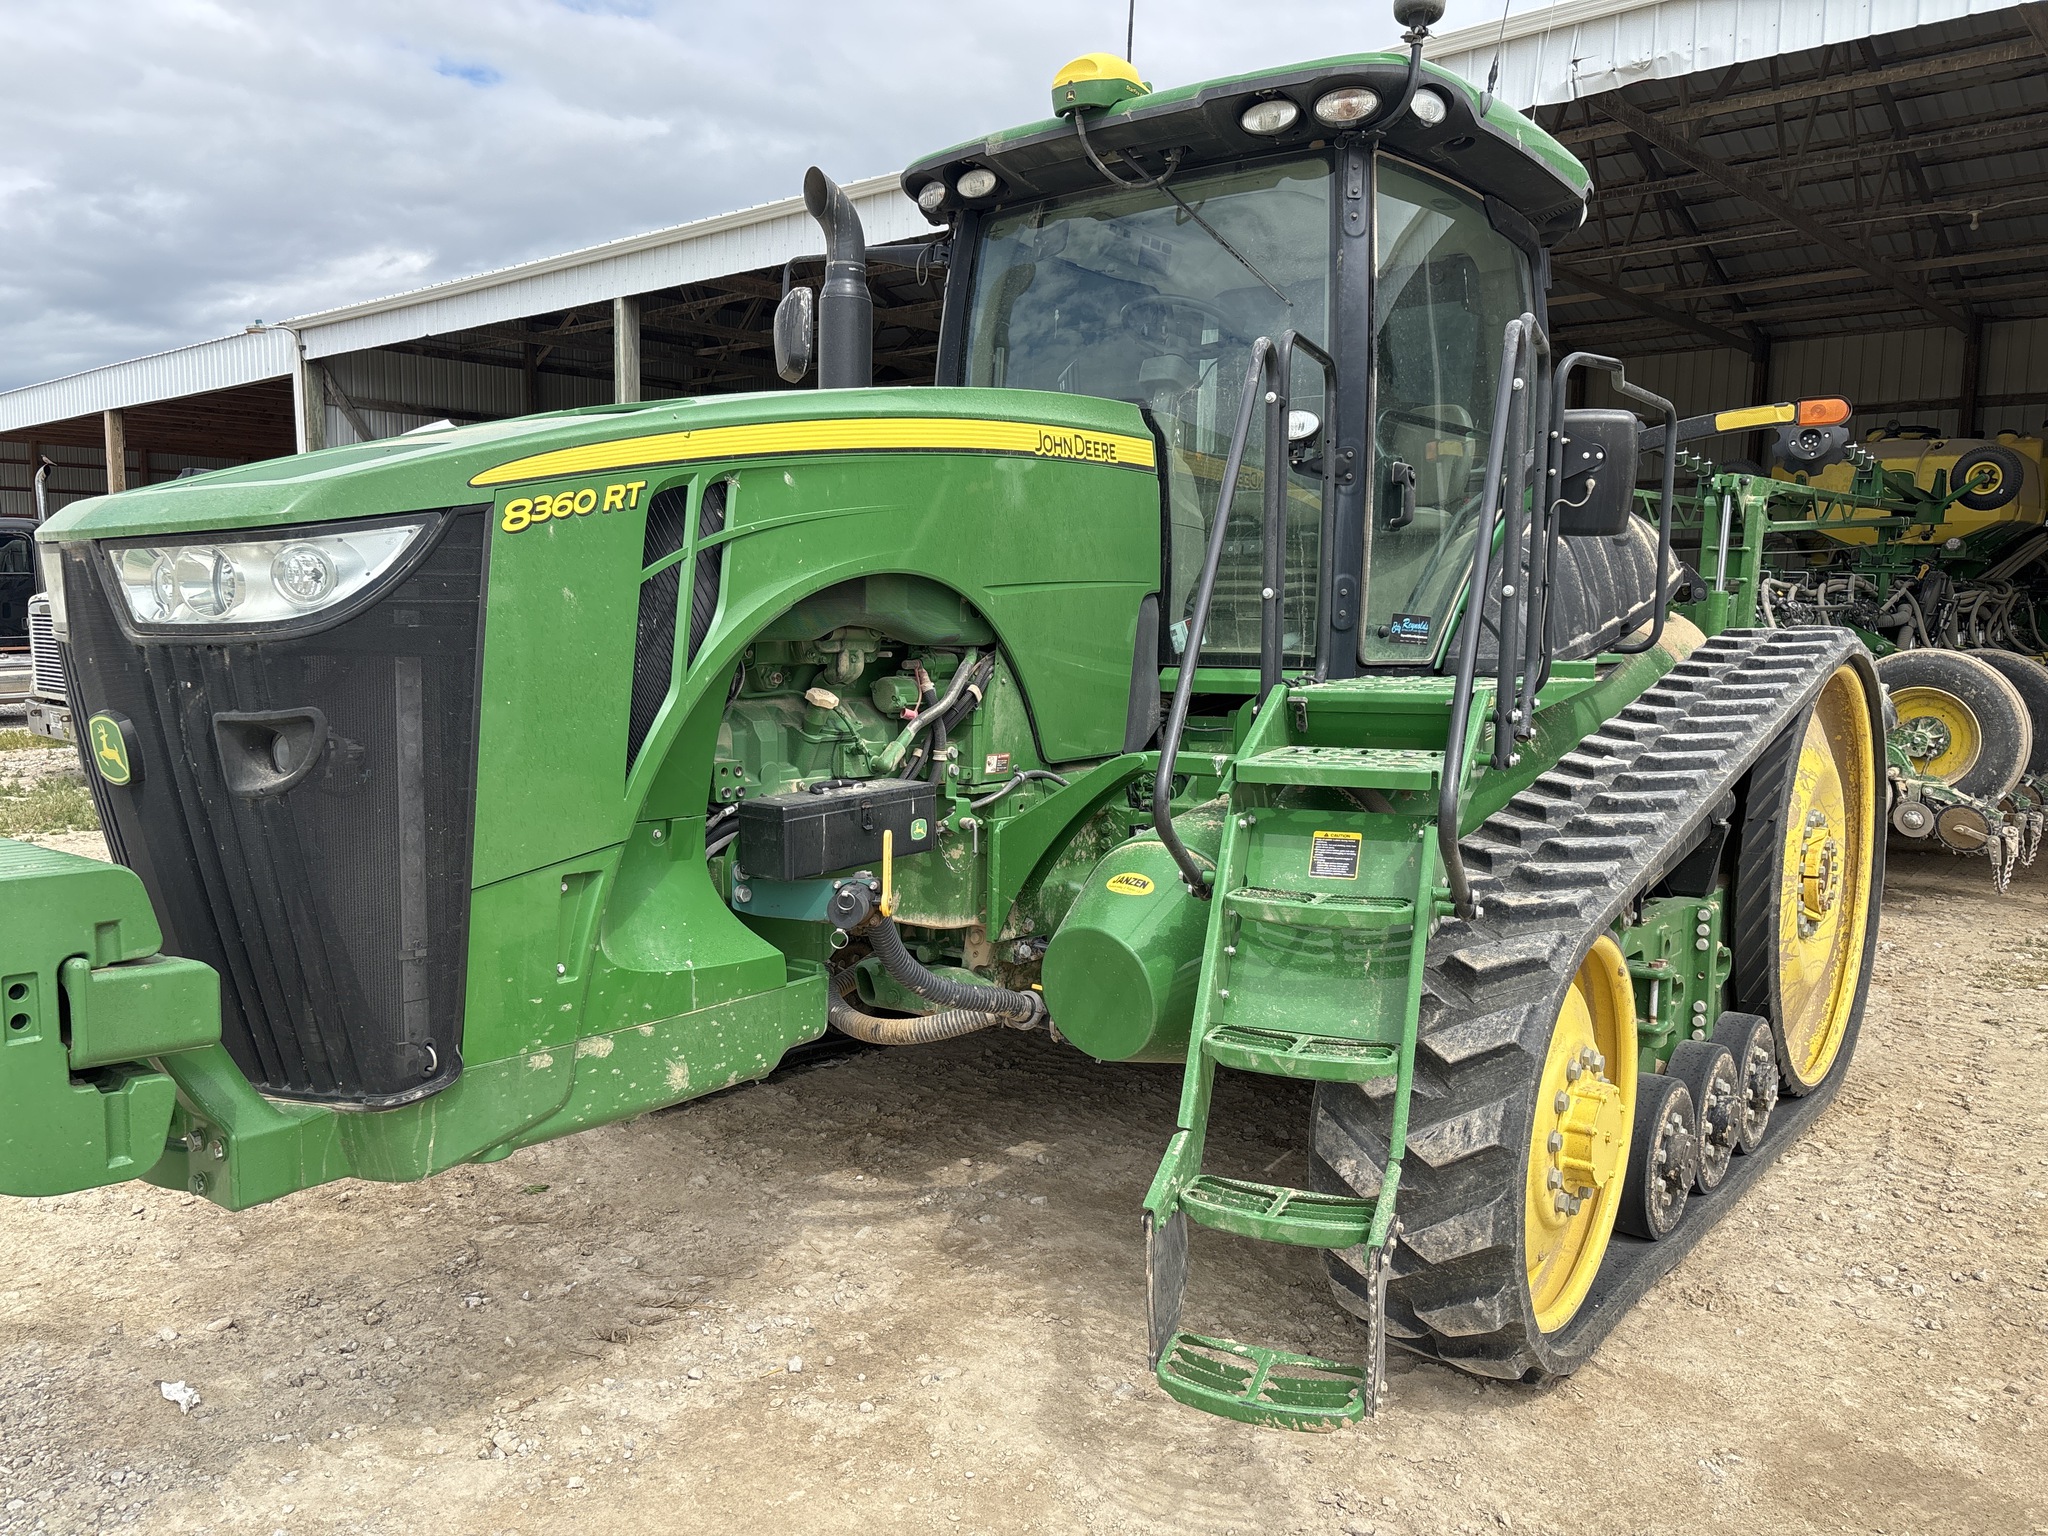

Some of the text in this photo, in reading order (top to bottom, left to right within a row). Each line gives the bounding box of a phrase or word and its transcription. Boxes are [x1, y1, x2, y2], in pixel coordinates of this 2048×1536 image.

[501, 480, 648, 534] 8360 RT
[1402, 617, 1429, 631] Reynolds
[1112, 875, 1150, 890] JANZEN
